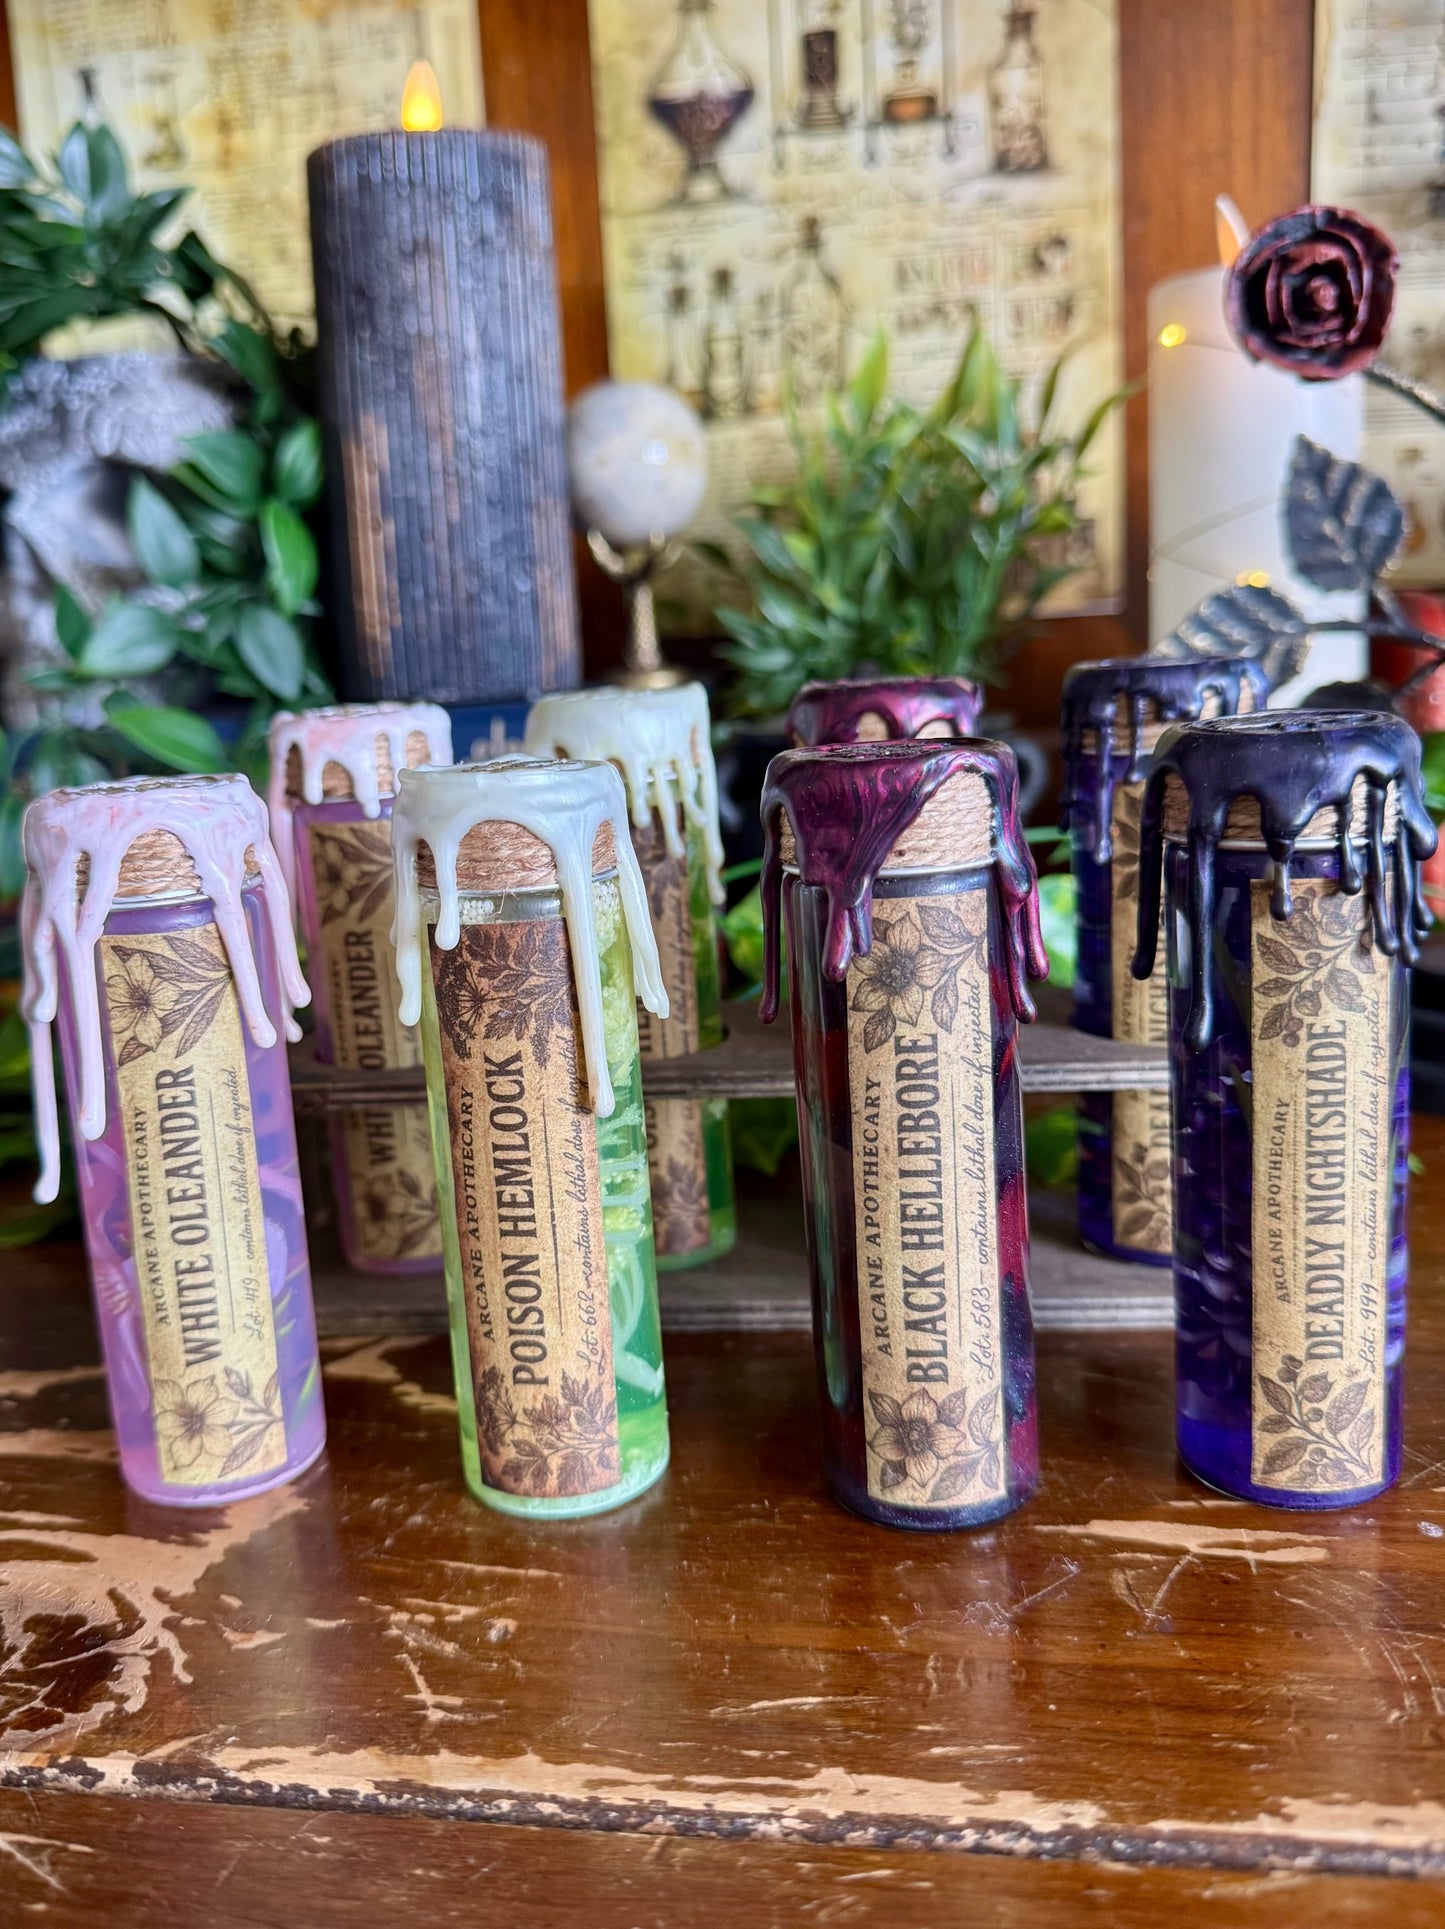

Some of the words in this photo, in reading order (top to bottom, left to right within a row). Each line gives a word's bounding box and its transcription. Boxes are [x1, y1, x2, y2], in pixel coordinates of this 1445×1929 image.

[345, 928, 386, 1070] OLEANDER
[961, 978, 992, 1054] injected
[1365, 988, 1385, 1067] injected
[221, 1066, 249, 1120] injected
[556, 1034, 588, 1097] injected
[960, 1056, 992, 1078] if
[962, 1081, 984, 1121] dose
[1360, 1070, 1386, 1087] if
[225, 1122, 251, 1136] if
[365, 1110, 395, 1166] WHI
[557, 1098, 591, 1115] if
[565, 1120, 583, 1151] dose
[895, 1033, 944, 1251] HELLEBORE
[1305, 1020, 1346, 1226] NIGHTSHADE
[1361, 1092, 1379, 1125] dose
[134, 1106, 156, 1240] APOTHECARY
[155, 1065, 210, 1245] OLEANDER
[228, 1138, 245, 1164] dose
[461, 1085, 480, 1241] APOTHECARY
[483, 1050, 537, 1239] HEMLOCK
[563, 1152, 586, 1202] lethal
[863, 1076, 881, 1247] APOTHECARY
[963, 1122, 986, 1182] lethal
[1268, 1098, 1290, 1221] APOTHECARY
[1358, 1126, 1378, 1182] lethal
[230, 1165, 249, 1204] lethal
[239, 1208, 255, 1259] contains
[572, 1205, 592, 1278] contains
[970, 1186, 989, 1264] contains
[1361, 1189, 1377, 1260] contains
[145, 1248, 170, 1325] ARCANE
[470, 1249, 495, 1342] ARCANE
[1268, 1228, 1291, 1304] ARCANE
[1304, 1237, 1344, 1362] DEADLY
[1359, 1282, 1378, 1320] 999
[175, 1254, 222, 1367] WHITE
[501, 1252, 548, 1385] POISON
[577, 1290, 597, 1326] 662
[867, 1256, 892, 1357] ARCANE
[902, 1261, 949, 1385] BLACK
[971, 1287, 991, 1328] 583
[1358, 1327, 1376, 1374] Lot:
